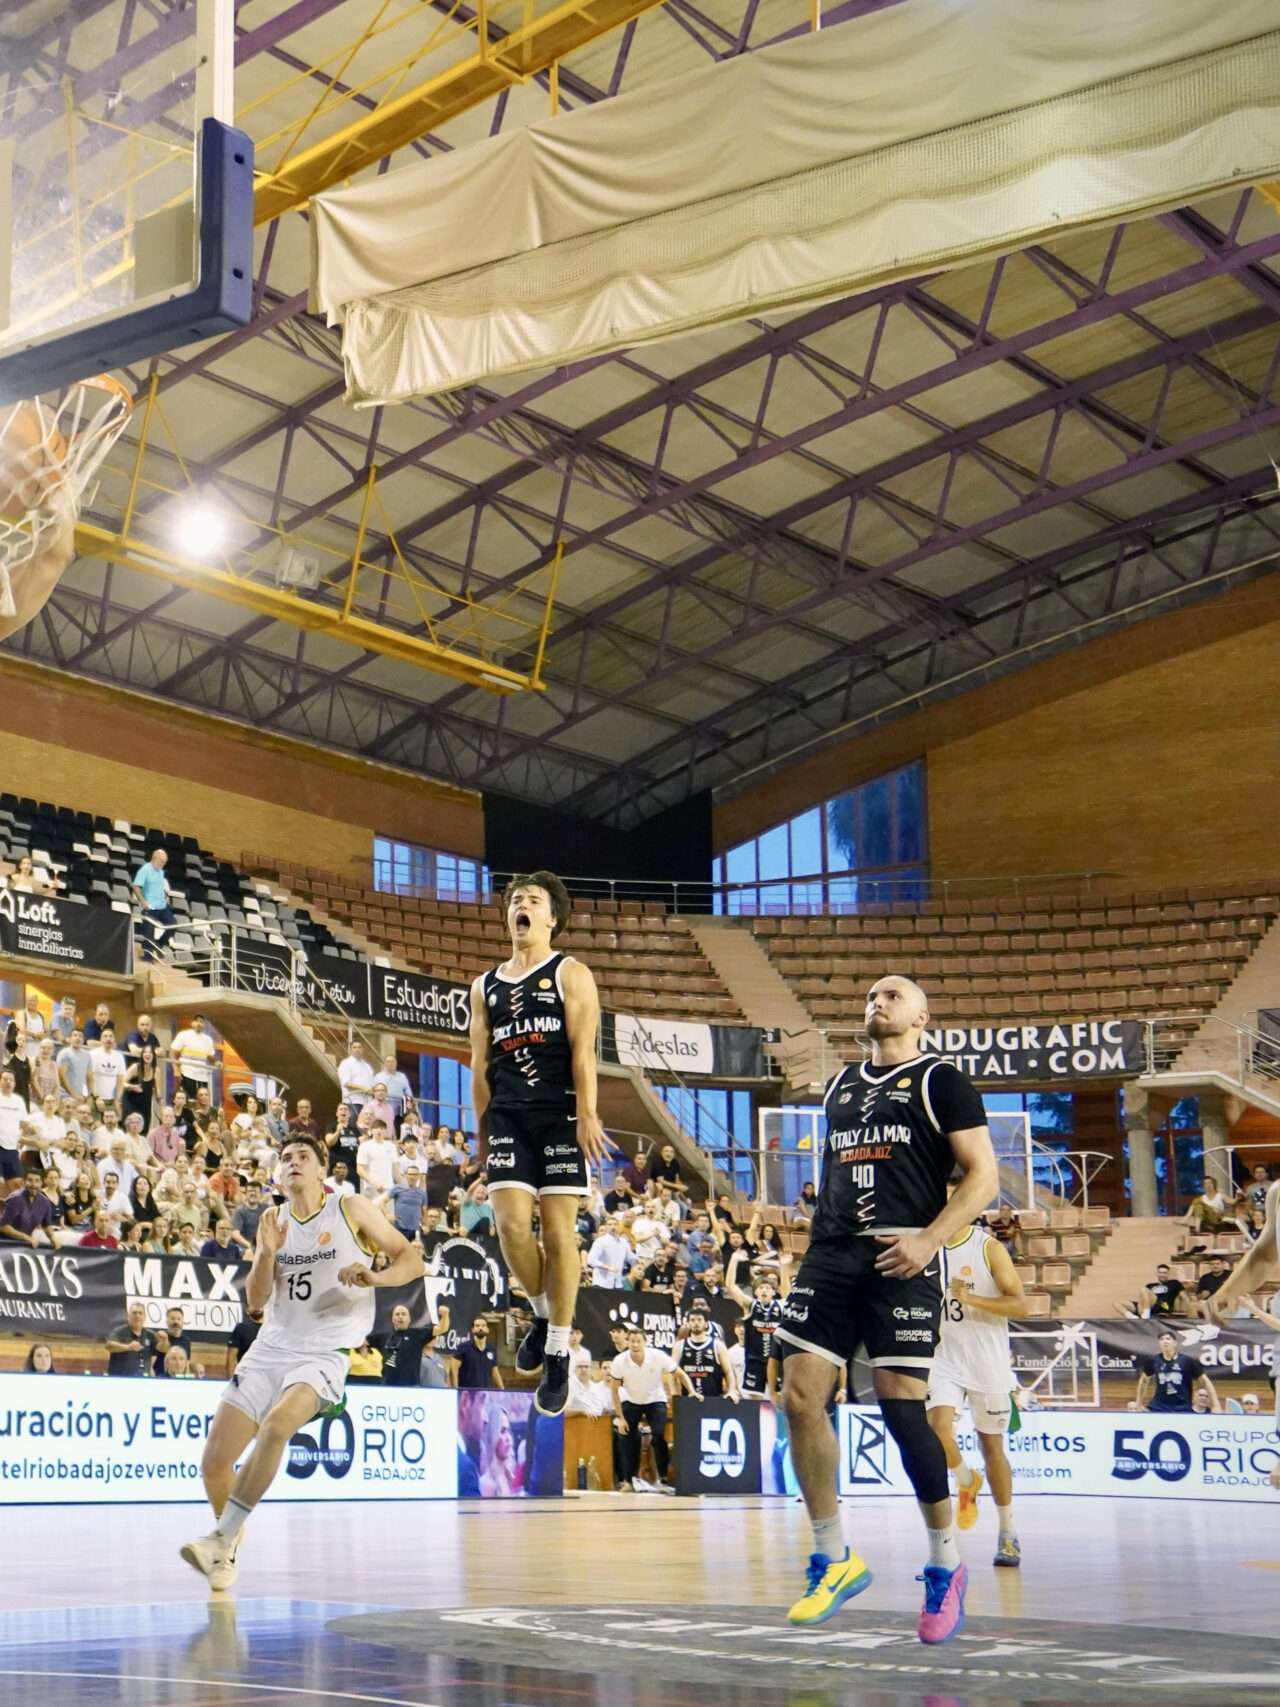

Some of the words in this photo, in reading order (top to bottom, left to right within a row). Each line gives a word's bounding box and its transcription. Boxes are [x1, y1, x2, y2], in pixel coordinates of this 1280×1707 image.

[18, 923, 64, 942] sinergias
[18, 937, 84, 960] inmobiliarias
[385, 1007, 452, 1029] arquitectos
[515, 1018, 533, 1035] LA
[534, 1016, 561, 1033] MAR
[630, 1029, 699, 1057] Adeslas
[921, 1021, 1123, 1052] NDUGRAFIC
[1048, 1048, 1126, 1074] COM
[864, 1126, 880, 1144] LA
[852, 1165, 874, 1189] 40
[124, 1257, 240, 1301] MAX
[288, 1271, 312, 1301] 15
[1200, 1343, 1274, 1374] aqua
[361, 1405, 426, 1423] GRUPO
[123, 1412, 141, 1446] y
[292, 1452, 350, 1463] ANIVERSARIO
[363, 1429, 426, 1464] RIO
[699, 1418, 745, 1478] 50
[1111, 1430, 1192, 1482] 50
[363, 1467, 426, 1481] BADAJOZ
[1117, 1461, 1186, 1472] ANIVERSARIO
